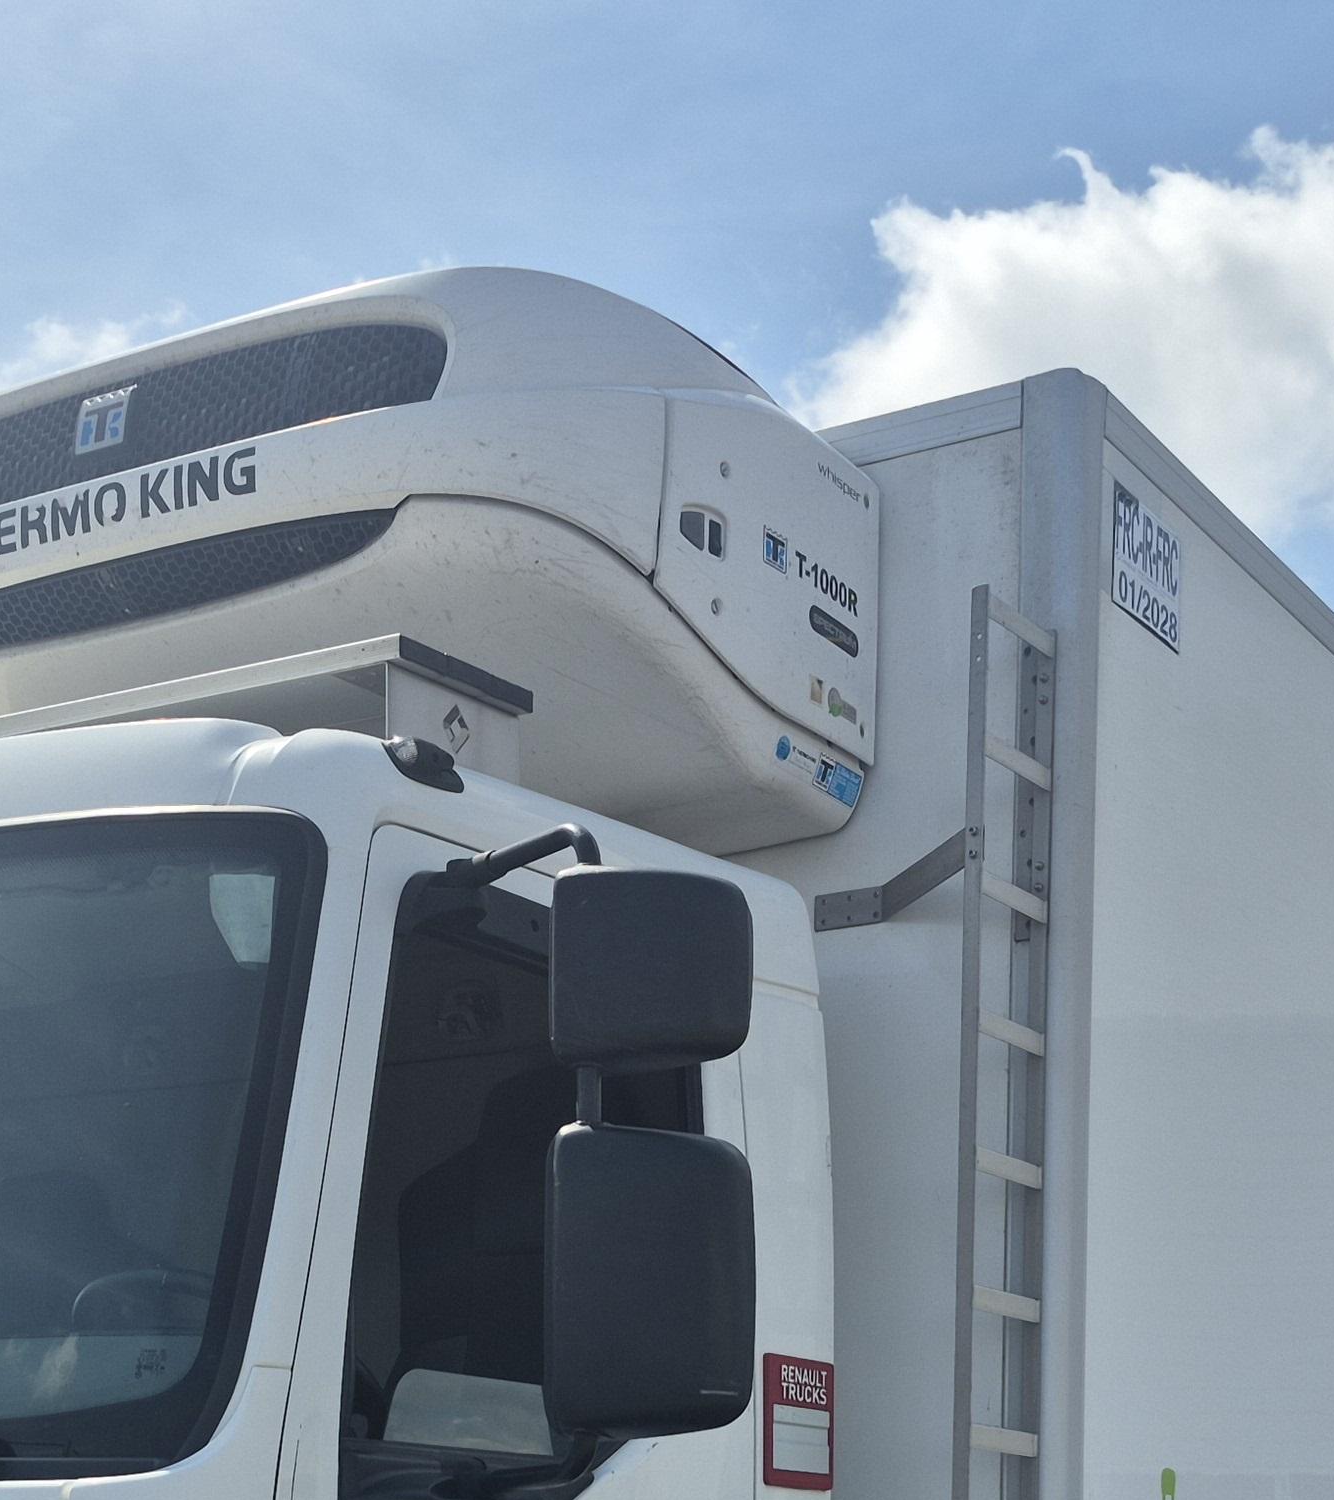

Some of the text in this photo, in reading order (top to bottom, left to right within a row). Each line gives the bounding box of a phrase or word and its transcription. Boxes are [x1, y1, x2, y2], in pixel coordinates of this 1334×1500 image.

[138, 446, 257, 519] KING
[817, 461, 861, 502] whisper
[794, 550, 859, 618] T-1000R
[1118, 570, 1178, 644] 01/2028
[781, 1364, 827, 1387] RENAULT
[781, 1382, 827, 1405] TRUCKS
